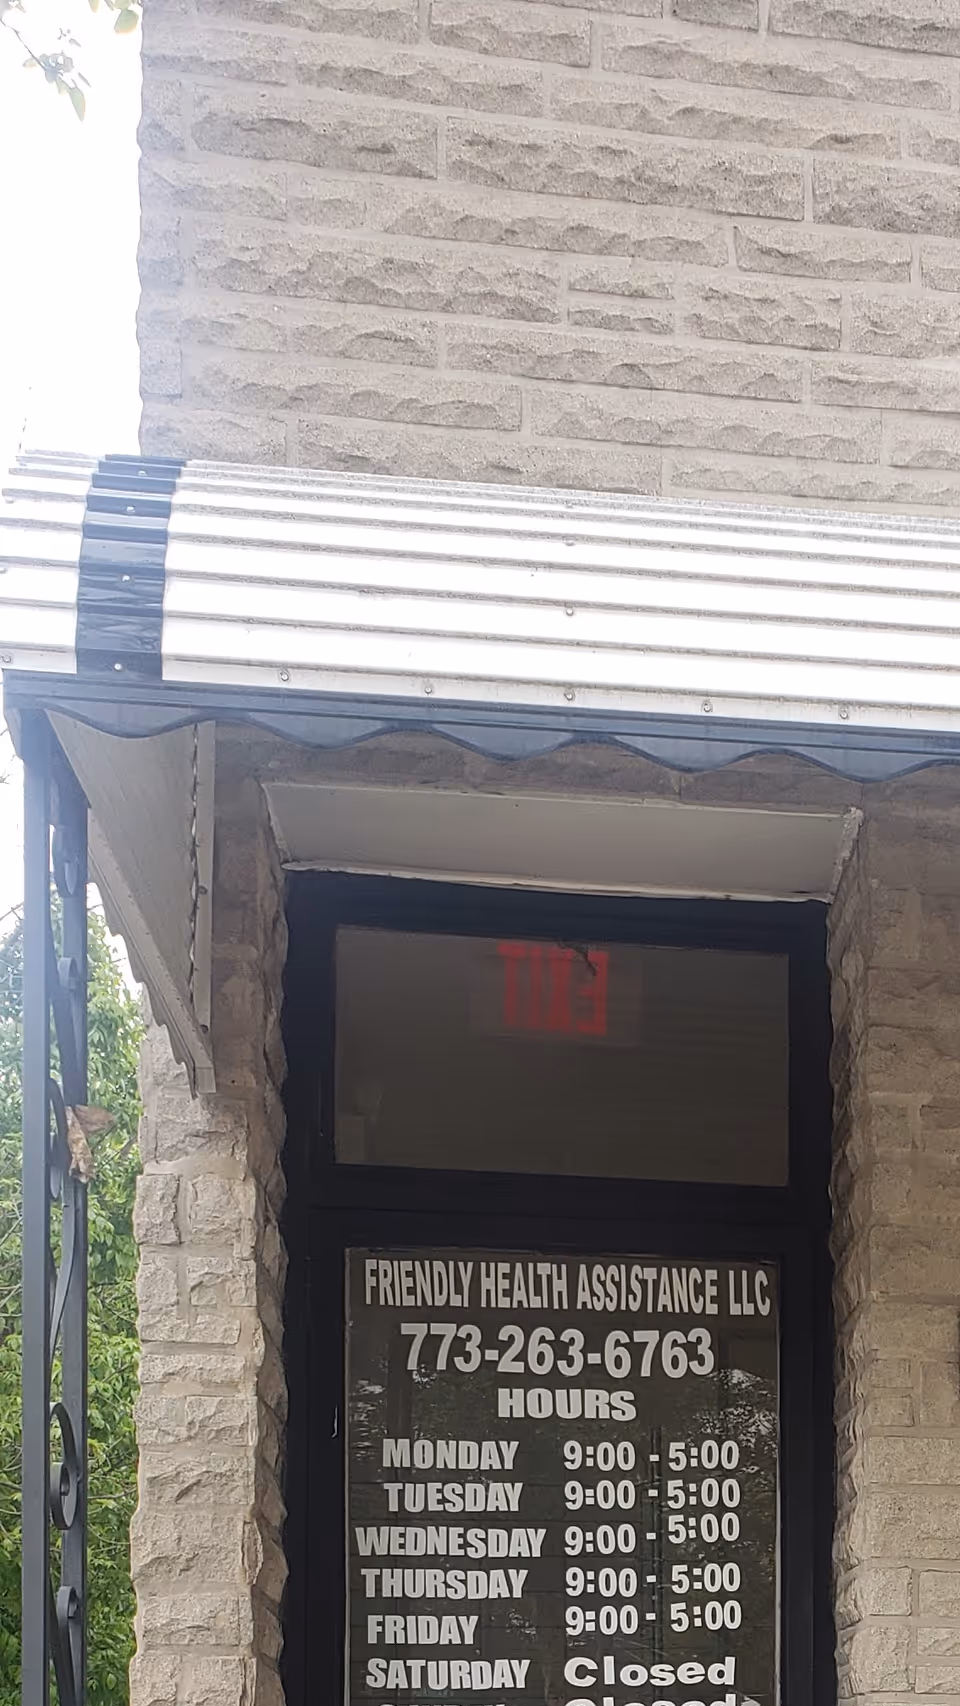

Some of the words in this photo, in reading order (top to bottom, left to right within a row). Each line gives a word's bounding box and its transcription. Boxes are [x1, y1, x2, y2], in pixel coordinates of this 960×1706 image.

[366, 1260, 473, 1307] FRIENDLY
[481, 1262, 568, 1309] HEALTH
[577, 1264, 717, 1314] ASSISTANCE
[729, 1271, 770, 1315] LLC
[401, 1323, 714, 1378] 773-263-6763
[498, 1388, 636, 1421] HOURS
[383, 1439, 519, 1469] MONDAY
[564, 1441, 635, 1471] 9:00
[669, 1440, 739, 1471] 5:00
[384, 1482, 523, 1512] TUESDAY
[565, 1480, 635, 1510] 9:00
[667, 1478, 740, 1509] 5:00
[355, 1526, 546, 1558] WEDNESDAY
[565, 1524, 635, 1555] 9:00
[668, 1513, 739, 1543] 5:00
[361, 1569, 528, 1599] THURSDAY
[566, 1567, 637, 1597] 9:00
[671, 1563, 740, 1593] 5:00
[368, 1615, 478, 1644] FRIDAY
[566, 1605, 638, 1635] 9:00
[671, 1600, 741, 1632] 5:00
[366, 1658, 530, 1690] SATURDAY
[564, 1656, 735, 1687] Closed
